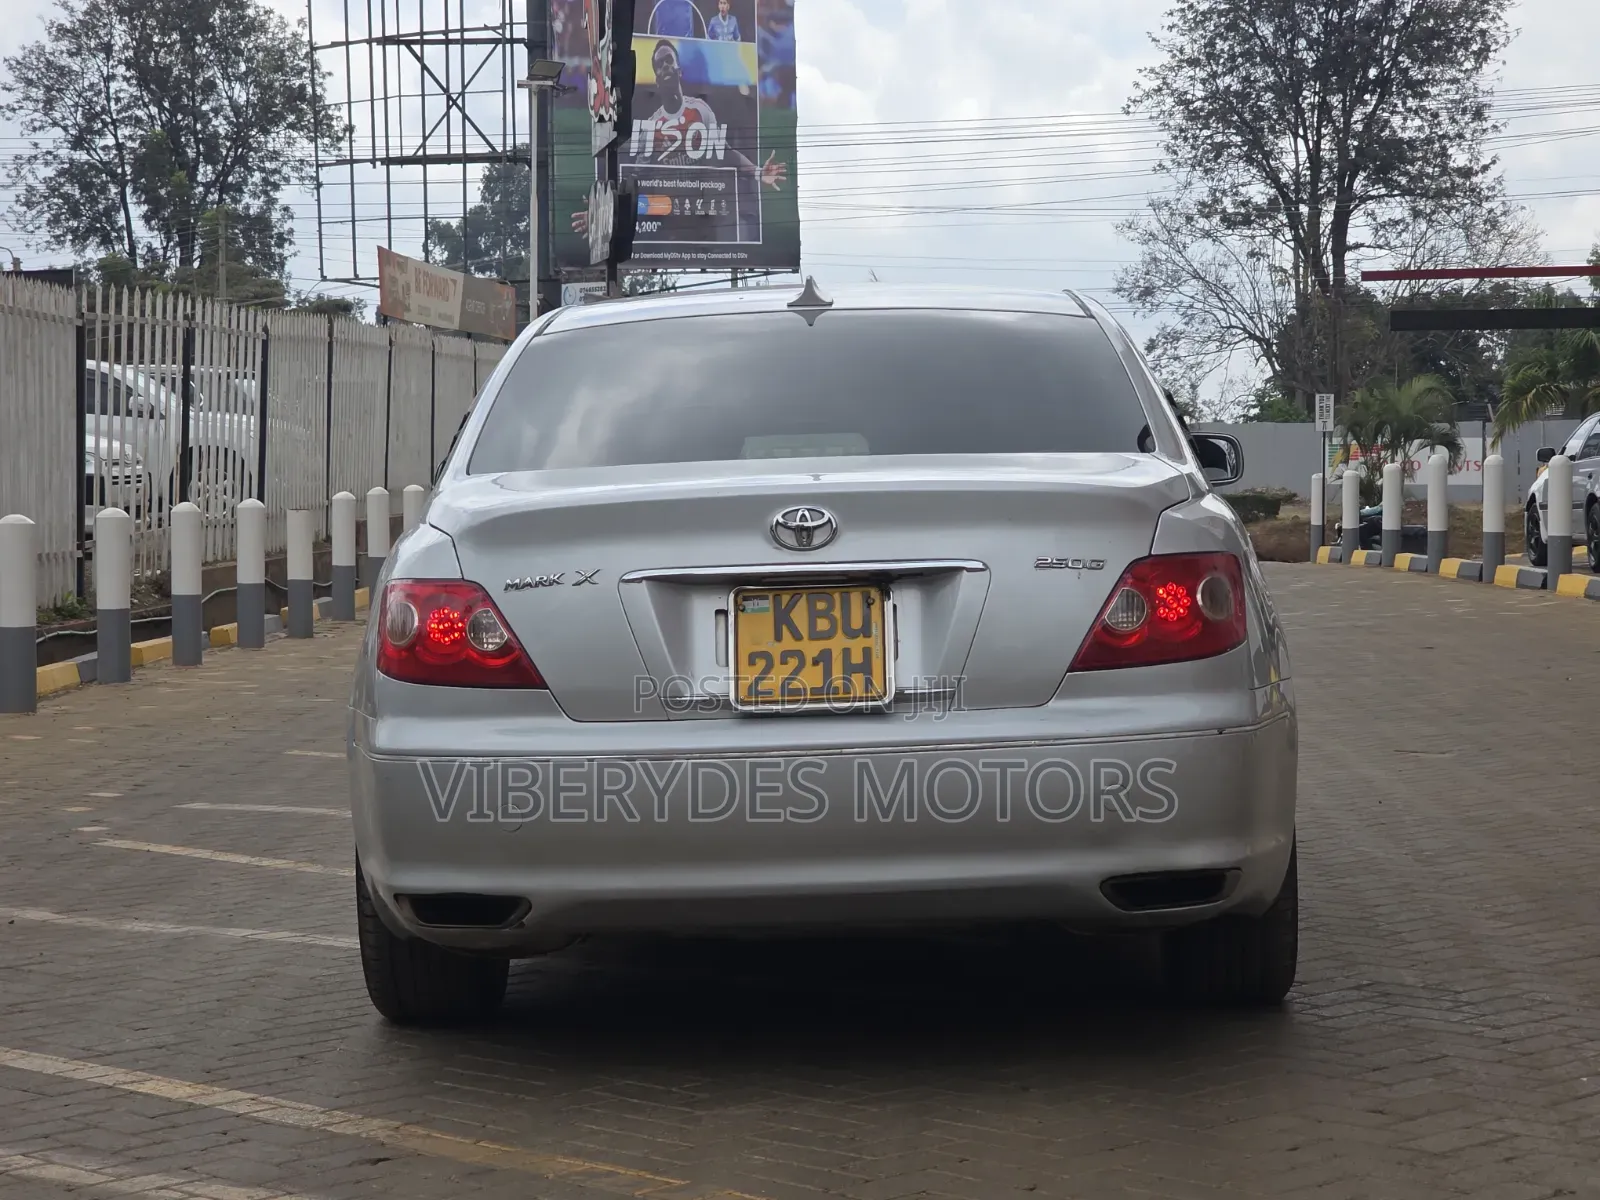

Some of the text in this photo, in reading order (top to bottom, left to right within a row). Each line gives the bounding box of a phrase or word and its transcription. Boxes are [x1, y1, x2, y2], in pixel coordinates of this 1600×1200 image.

[686, 122, 728, 160] ON
[641, 179, 662, 188] world's
[663, 180, 676, 188] best
[676, 179, 700, 188] football
[700, 181, 726, 191] package
[503, 568, 603, 592] MARK X
[773, 591, 873, 642] KBU
[747, 646, 873, 698] 221H
